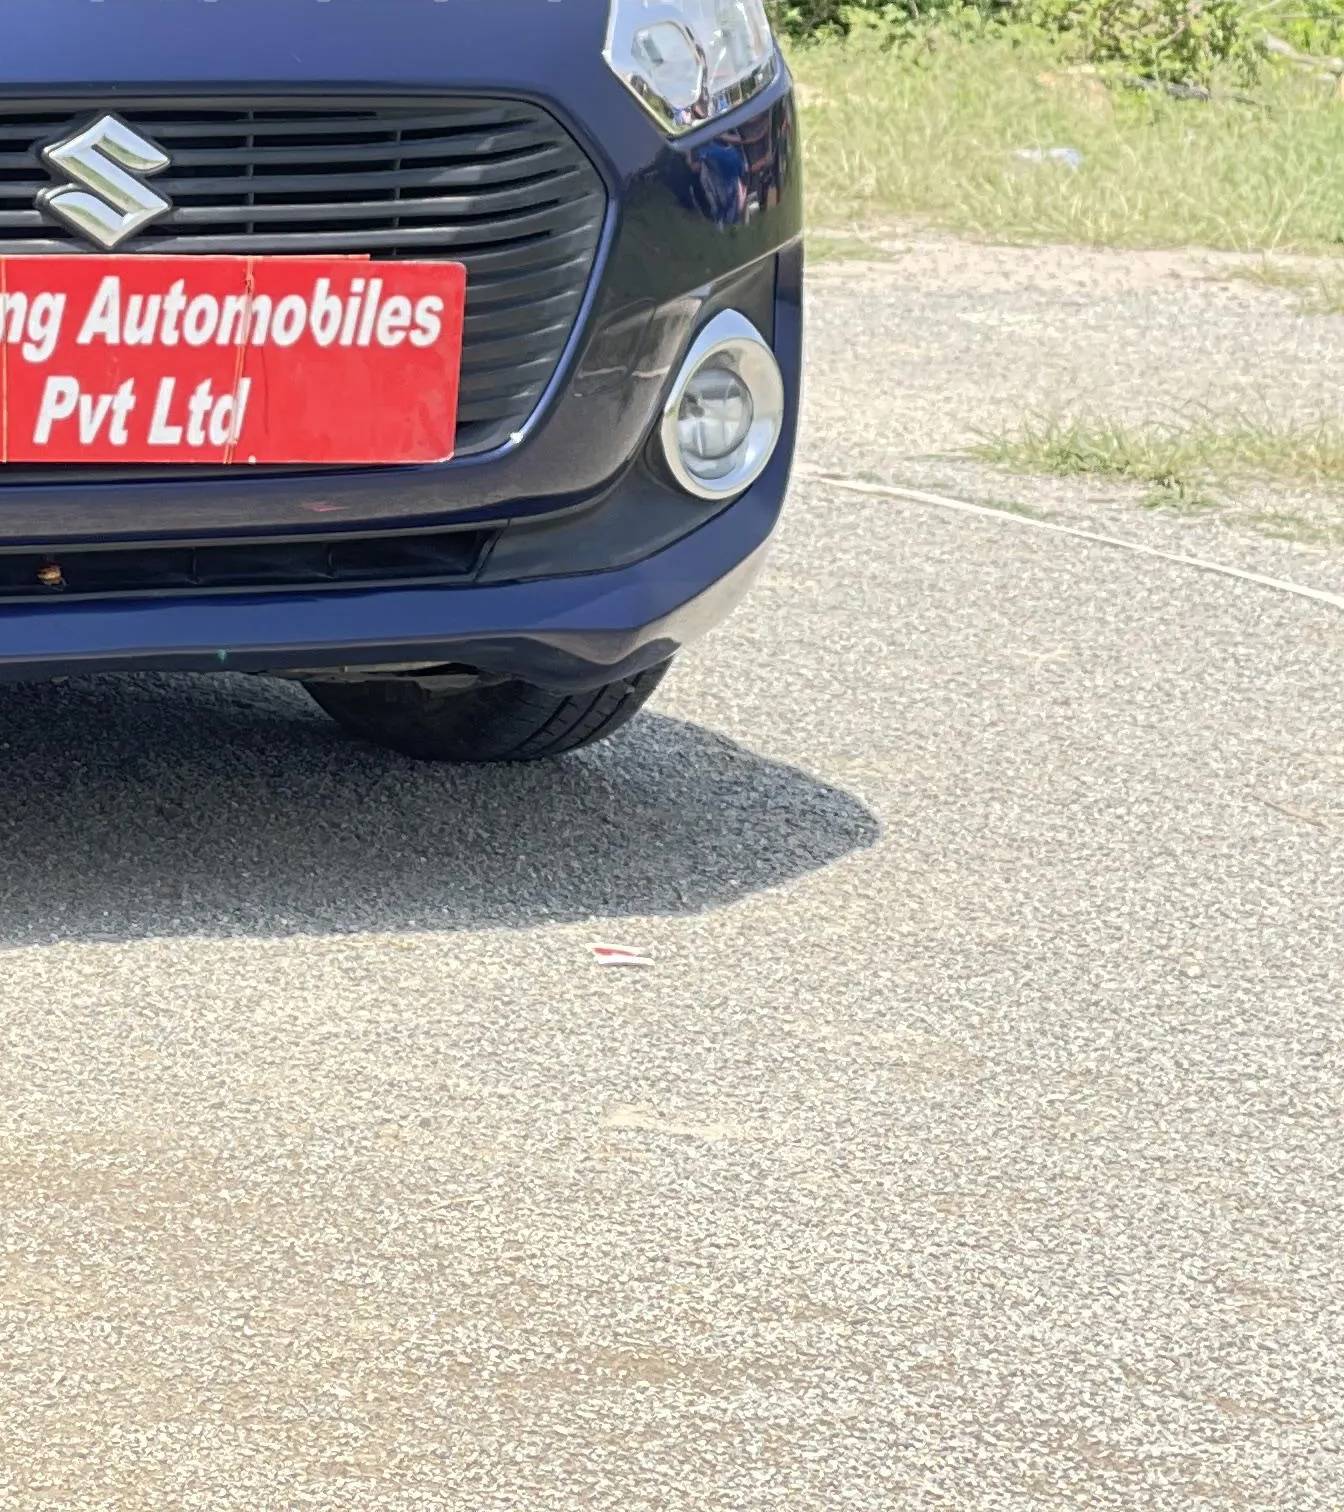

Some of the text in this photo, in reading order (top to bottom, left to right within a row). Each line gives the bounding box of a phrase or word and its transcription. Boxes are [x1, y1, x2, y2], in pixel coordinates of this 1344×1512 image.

[75, 274, 444, 349] Automobiles
[32, 375, 251, 447] Pvt Ltd
